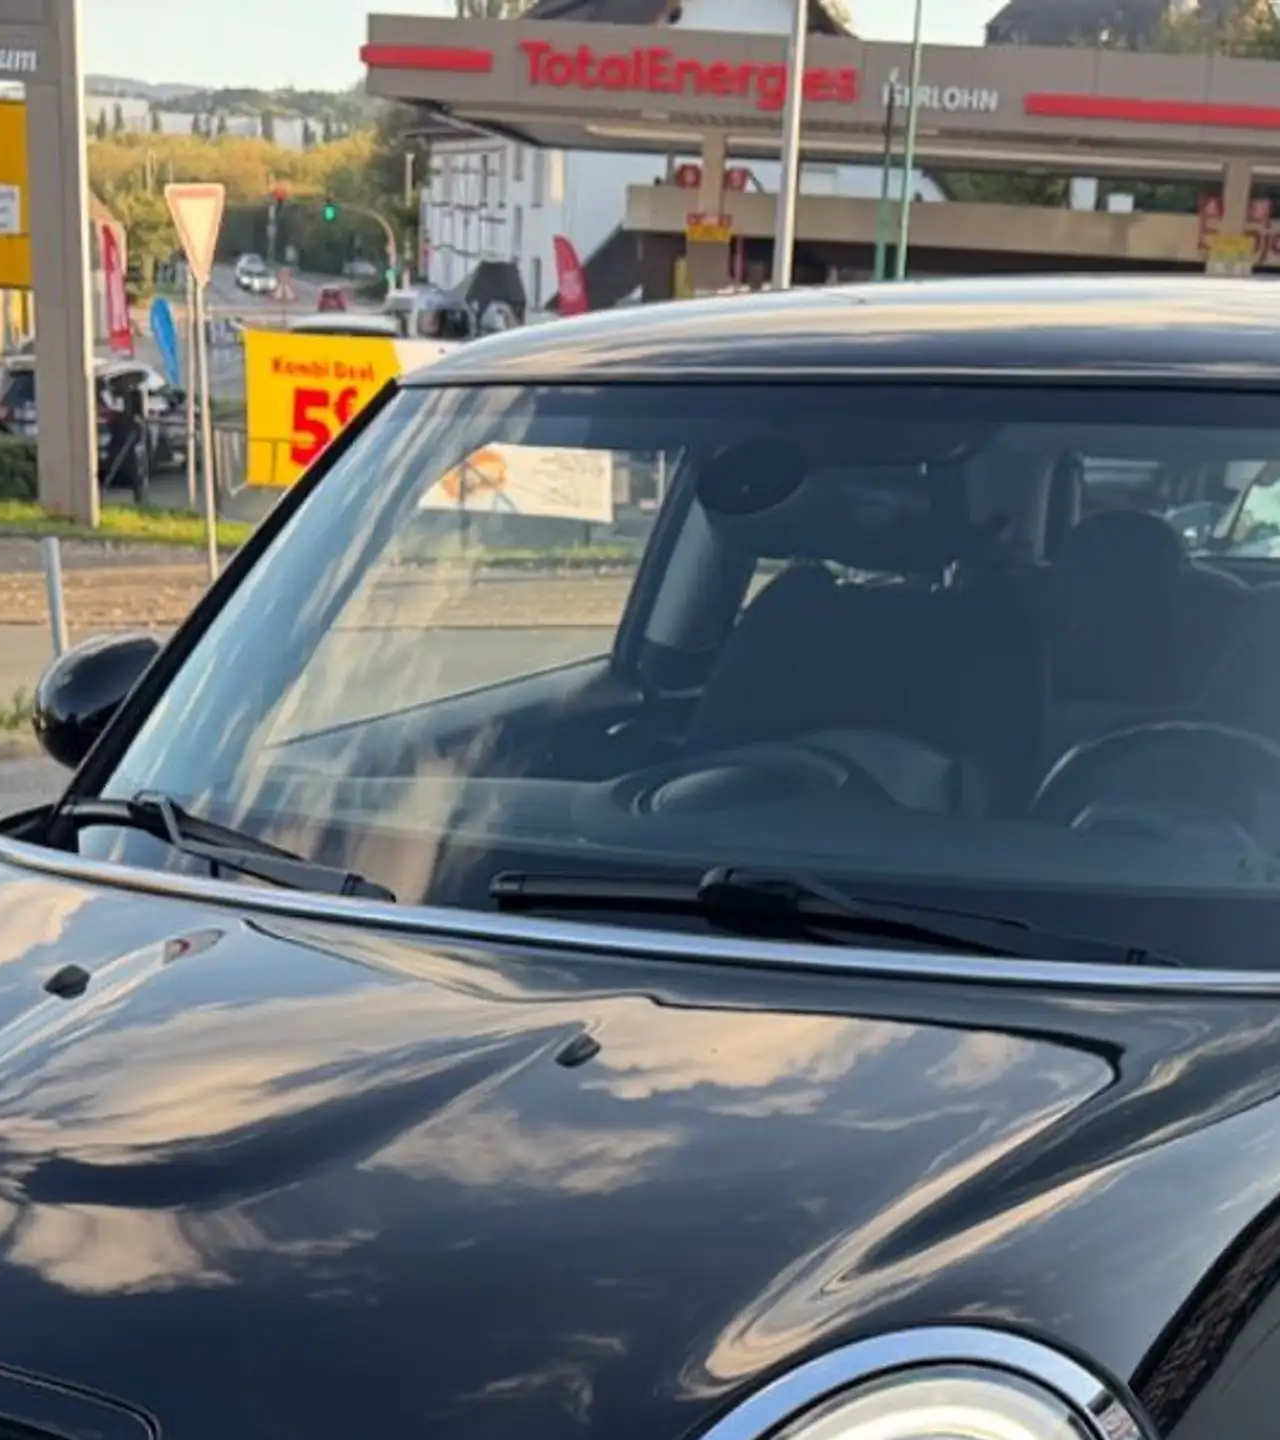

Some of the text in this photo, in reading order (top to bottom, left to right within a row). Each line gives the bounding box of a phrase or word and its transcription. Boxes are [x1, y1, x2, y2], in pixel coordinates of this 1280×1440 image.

[520, 40, 857, 111] TotalEnerges
[272, 356, 375, 381] Kombi Deal
